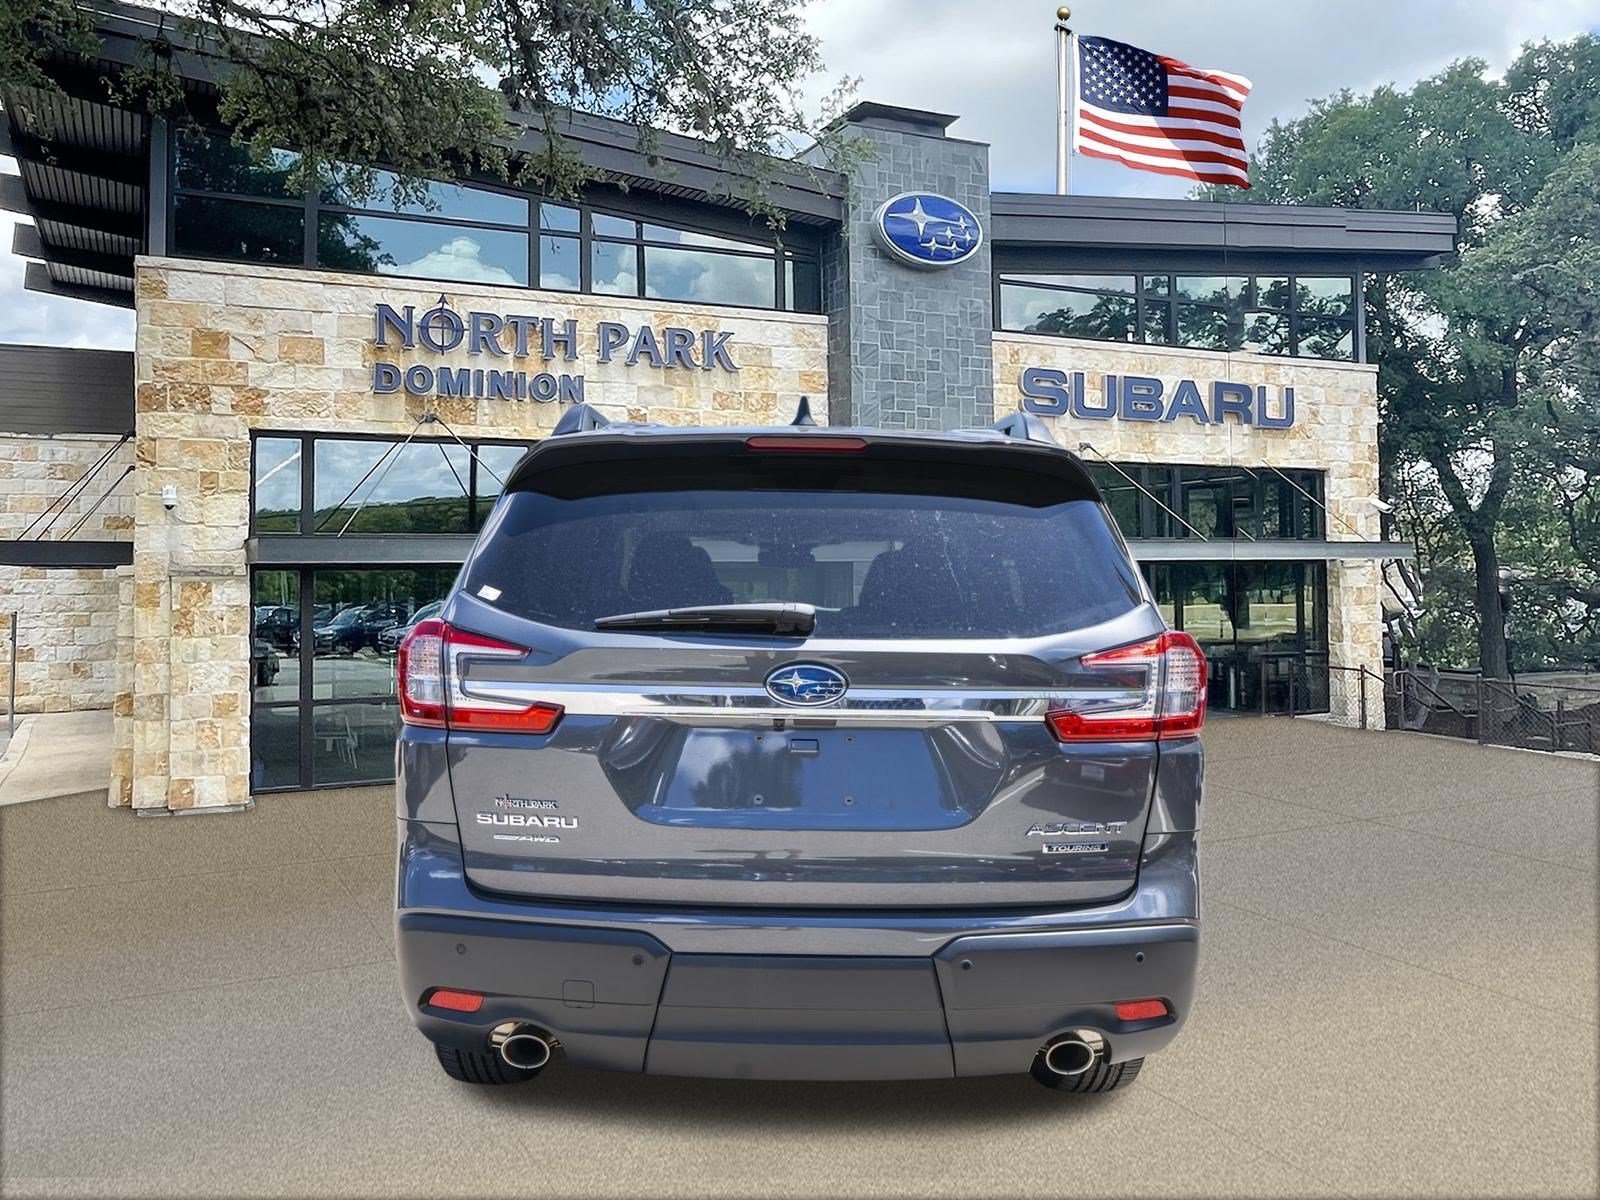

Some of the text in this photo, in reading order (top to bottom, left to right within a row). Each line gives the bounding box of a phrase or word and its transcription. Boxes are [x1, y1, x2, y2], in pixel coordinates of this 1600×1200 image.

[375, 297, 742, 372] NORTH PARK
[373, 362, 585, 403] DOMINION
[1018, 367, 1295, 429] SUBARU
[476, 813, 579, 829] SUBARU
[1025, 821, 1128, 836] ASCENT
[1051, 844, 1102, 853] TOURING
